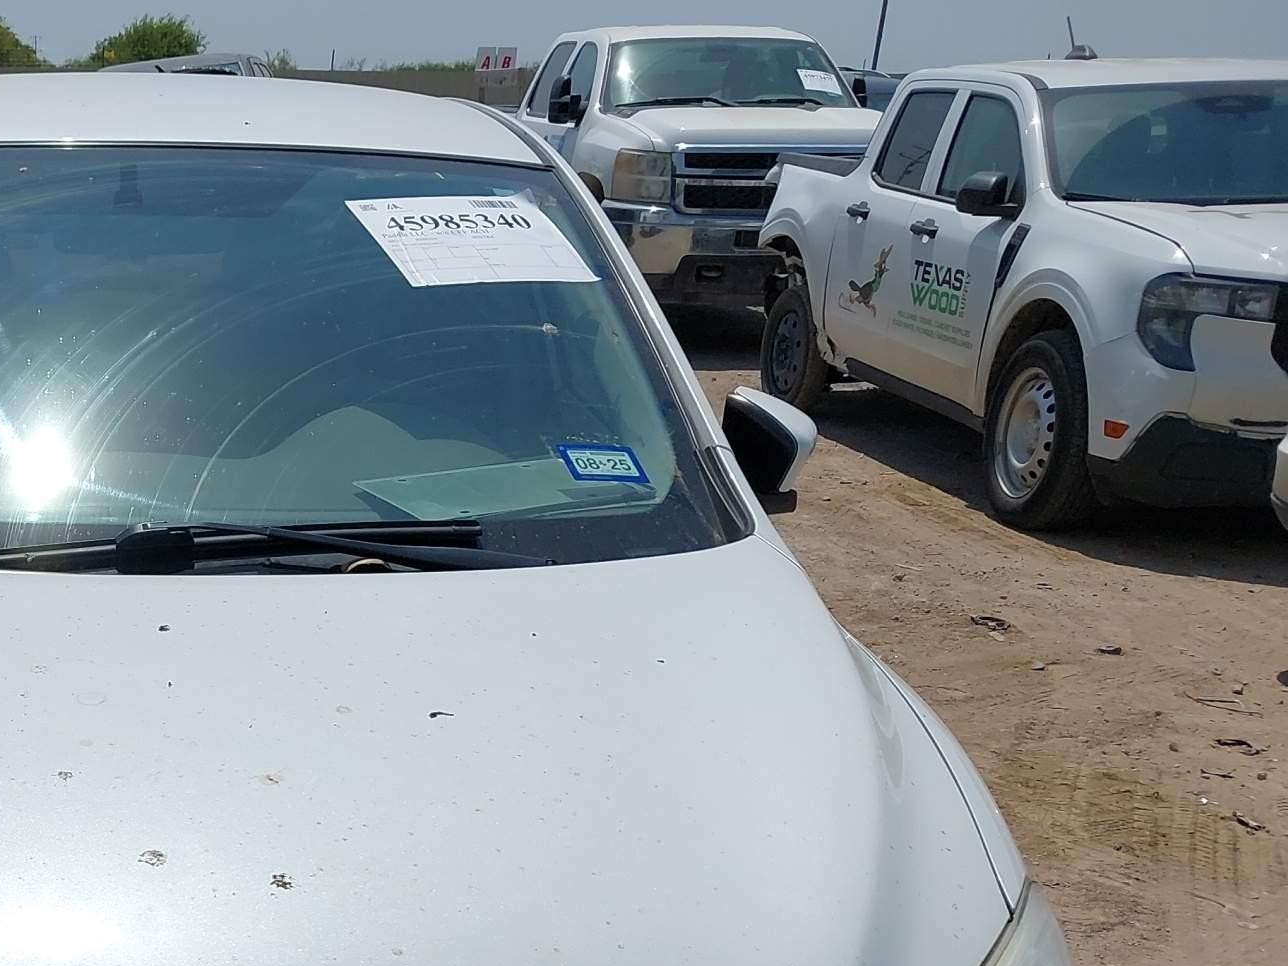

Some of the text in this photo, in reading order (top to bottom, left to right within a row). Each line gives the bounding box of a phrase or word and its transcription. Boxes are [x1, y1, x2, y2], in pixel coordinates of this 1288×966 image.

[481, 55, 491, 70] A
[502, 55, 512, 69] B
[386, 213, 532, 232] 45985340
[914, 259, 965, 292] TEXAS
[910, 281, 960, 316] WOOD
